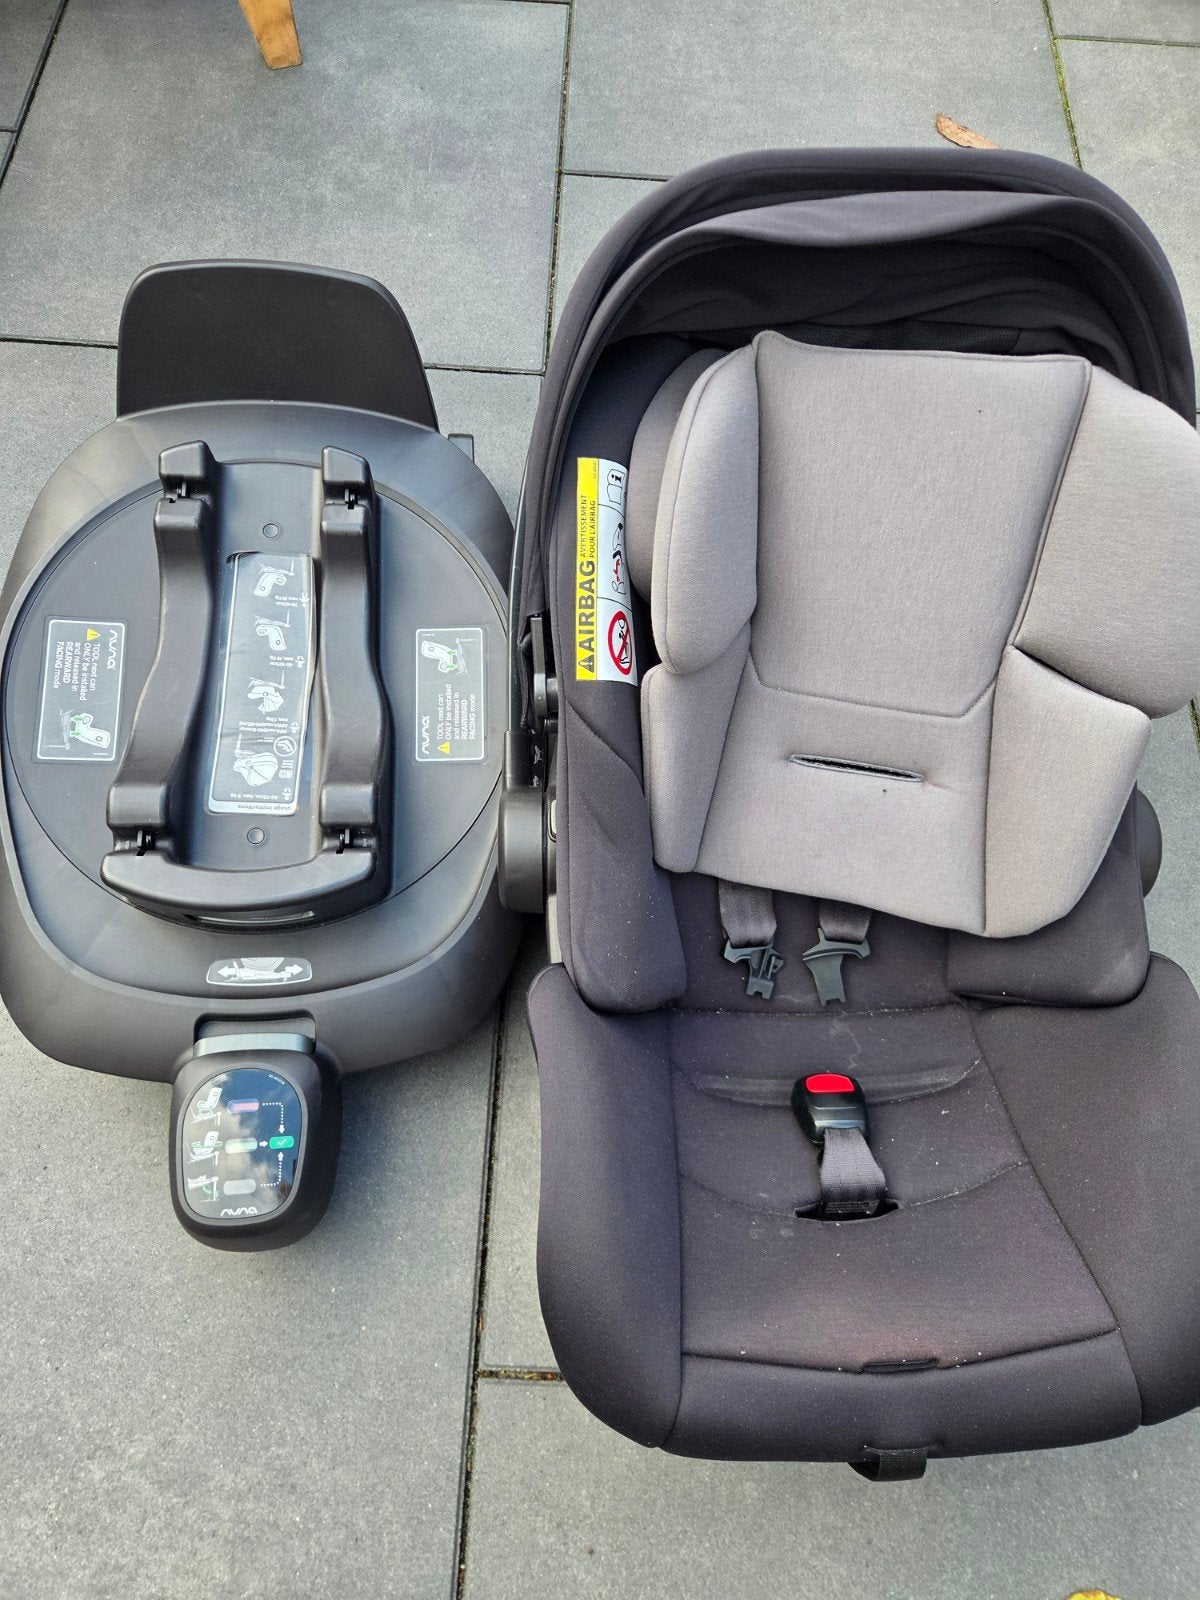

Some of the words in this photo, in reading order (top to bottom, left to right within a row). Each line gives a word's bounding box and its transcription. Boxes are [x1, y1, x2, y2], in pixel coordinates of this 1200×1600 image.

[579, 561, 595, 652] AIRBAG
[55, 642, 64, 668] FACING
[63, 642, 72, 683] REARWARD
[107, 630, 118, 669] nuna
[82, 663, 90, 671] be
[79, 673, 89, 700] installed
[445, 712, 451, 720] be
[421, 716, 429, 754] nuna
[221, 1207, 257, 1216] nuna
